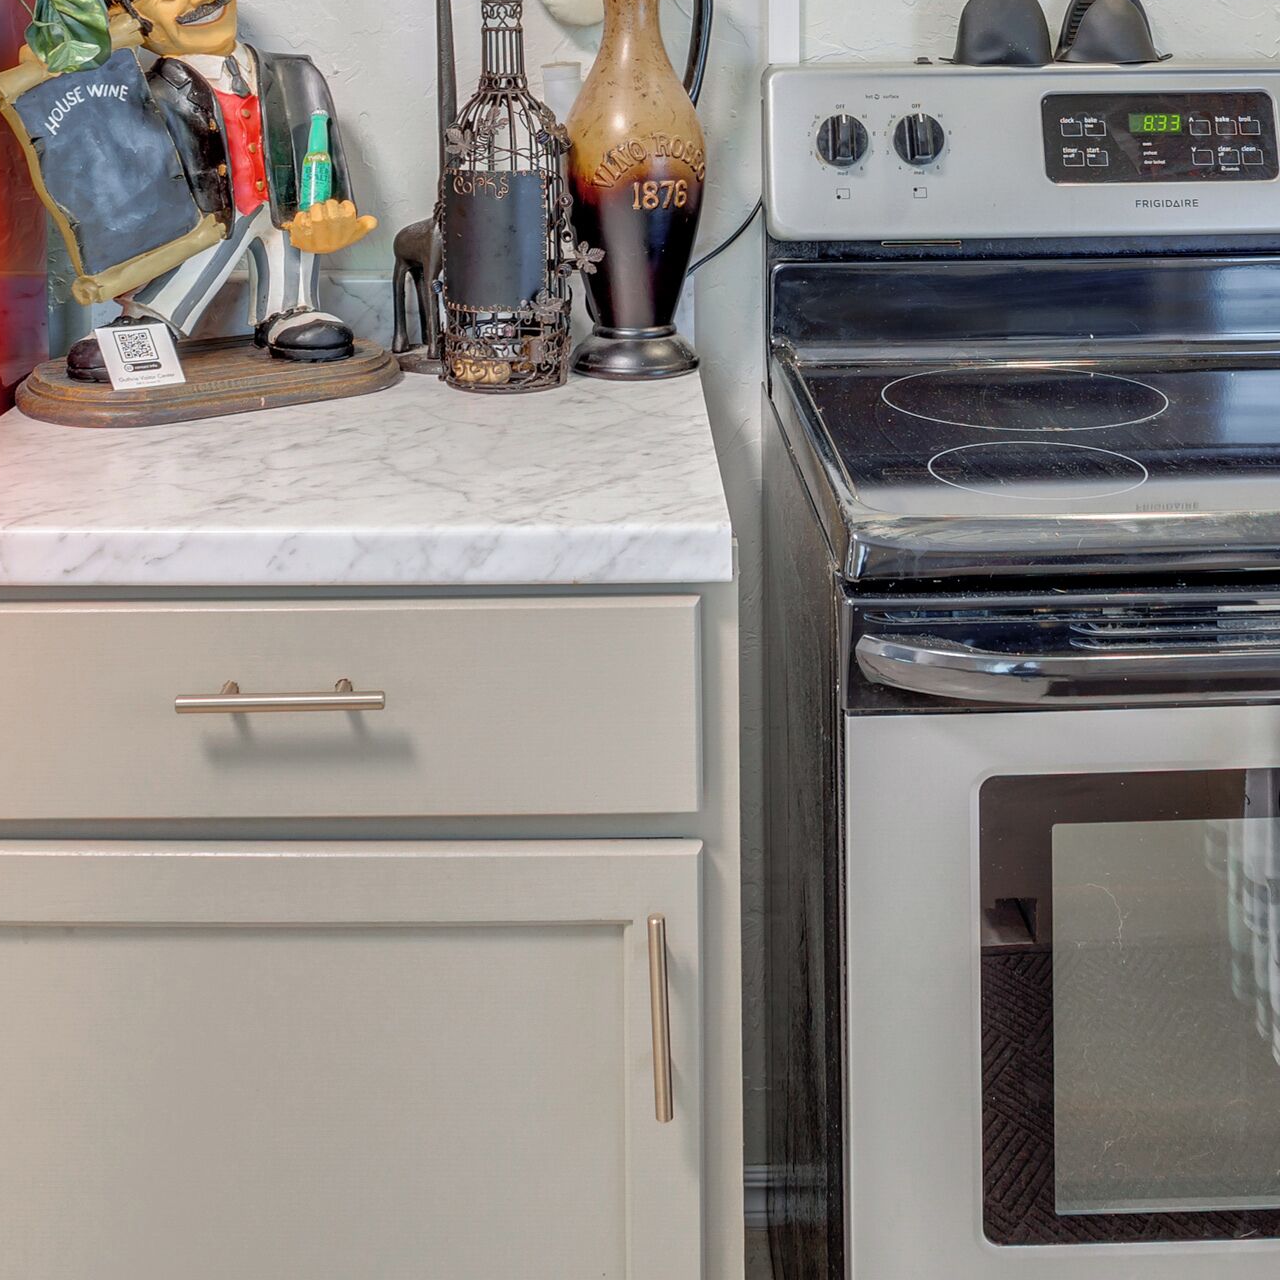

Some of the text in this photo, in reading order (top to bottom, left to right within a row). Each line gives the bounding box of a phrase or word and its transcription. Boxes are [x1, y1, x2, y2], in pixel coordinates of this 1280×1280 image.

[44, 84, 129, 136] HOUSE WINE
[591, 139, 647, 188] VINO
[632, 179, 688, 210] 1876
[1135, 198, 1200, 208] FRIGIDAIRE
